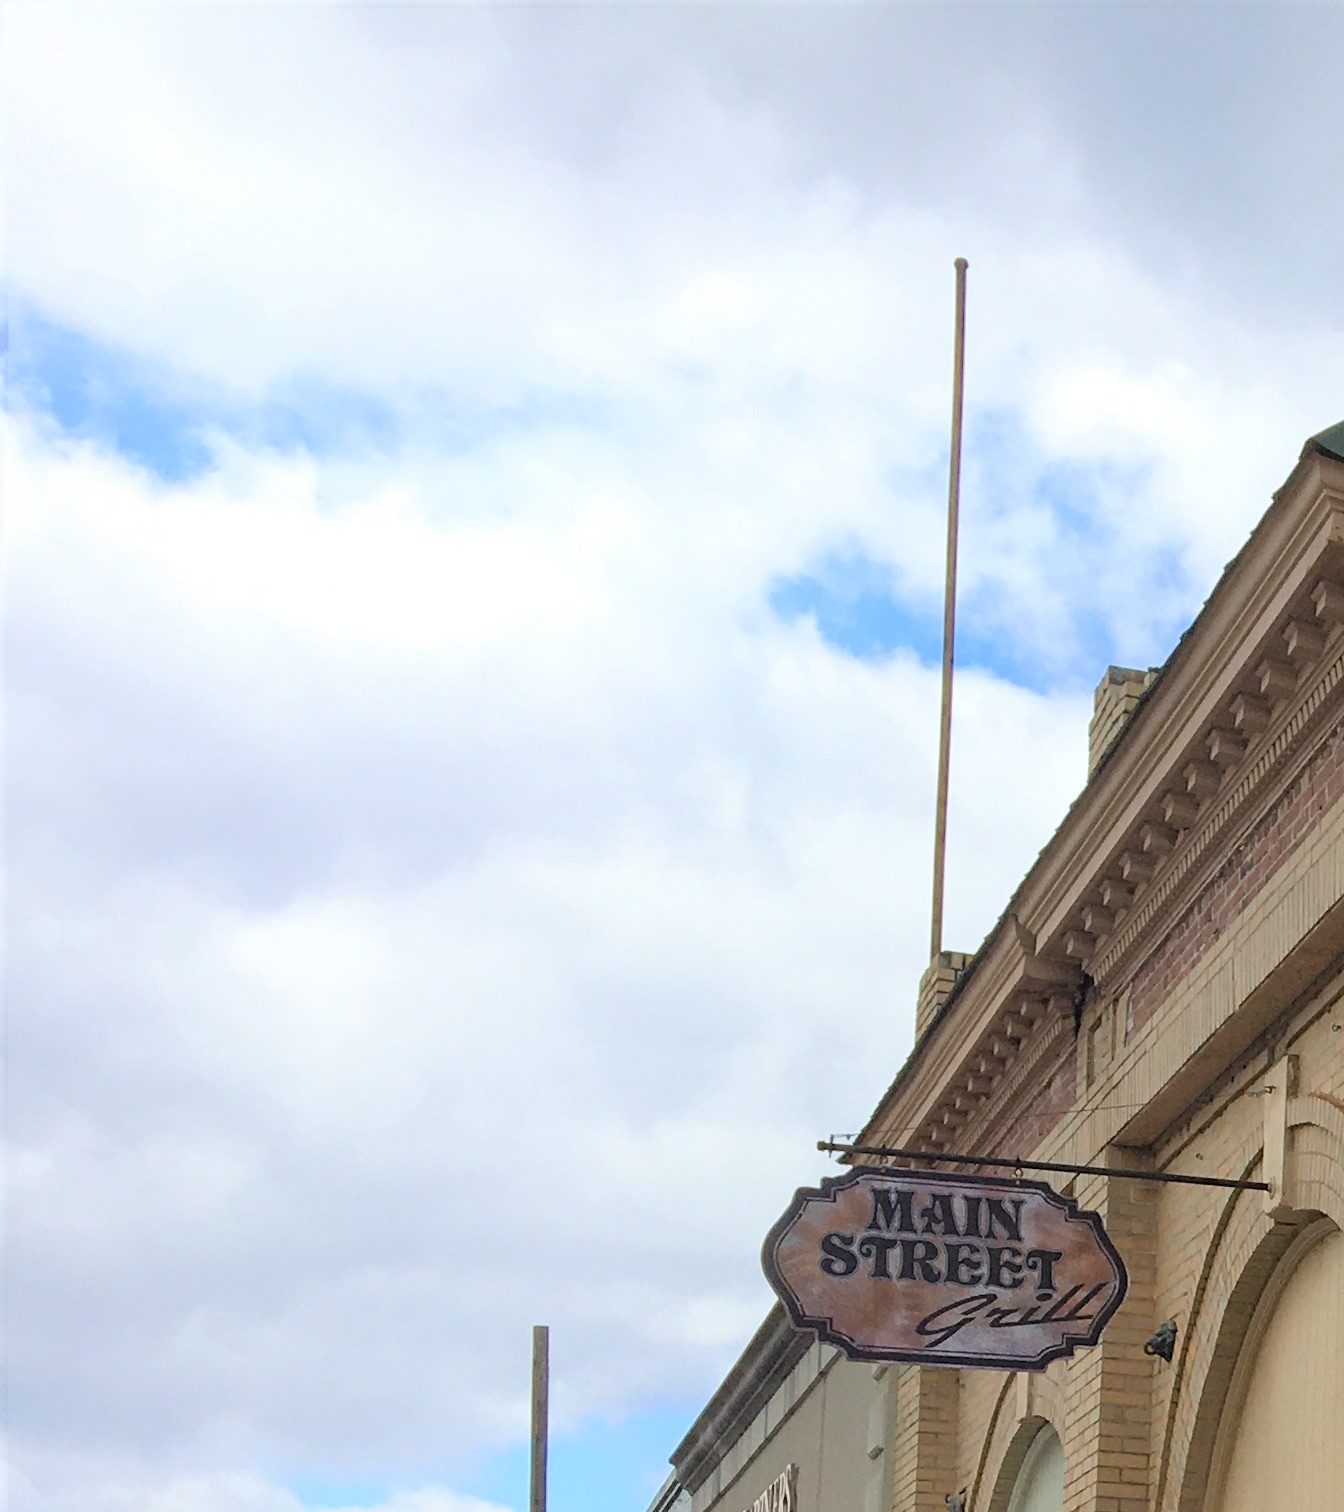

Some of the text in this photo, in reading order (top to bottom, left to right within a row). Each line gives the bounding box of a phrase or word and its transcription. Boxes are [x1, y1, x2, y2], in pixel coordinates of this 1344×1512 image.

[865, 1186, 1027, 1242] MAIN
[820, 1232, 1064, 1292] STREET
[915, 1282, 1110, 1348] Grill
